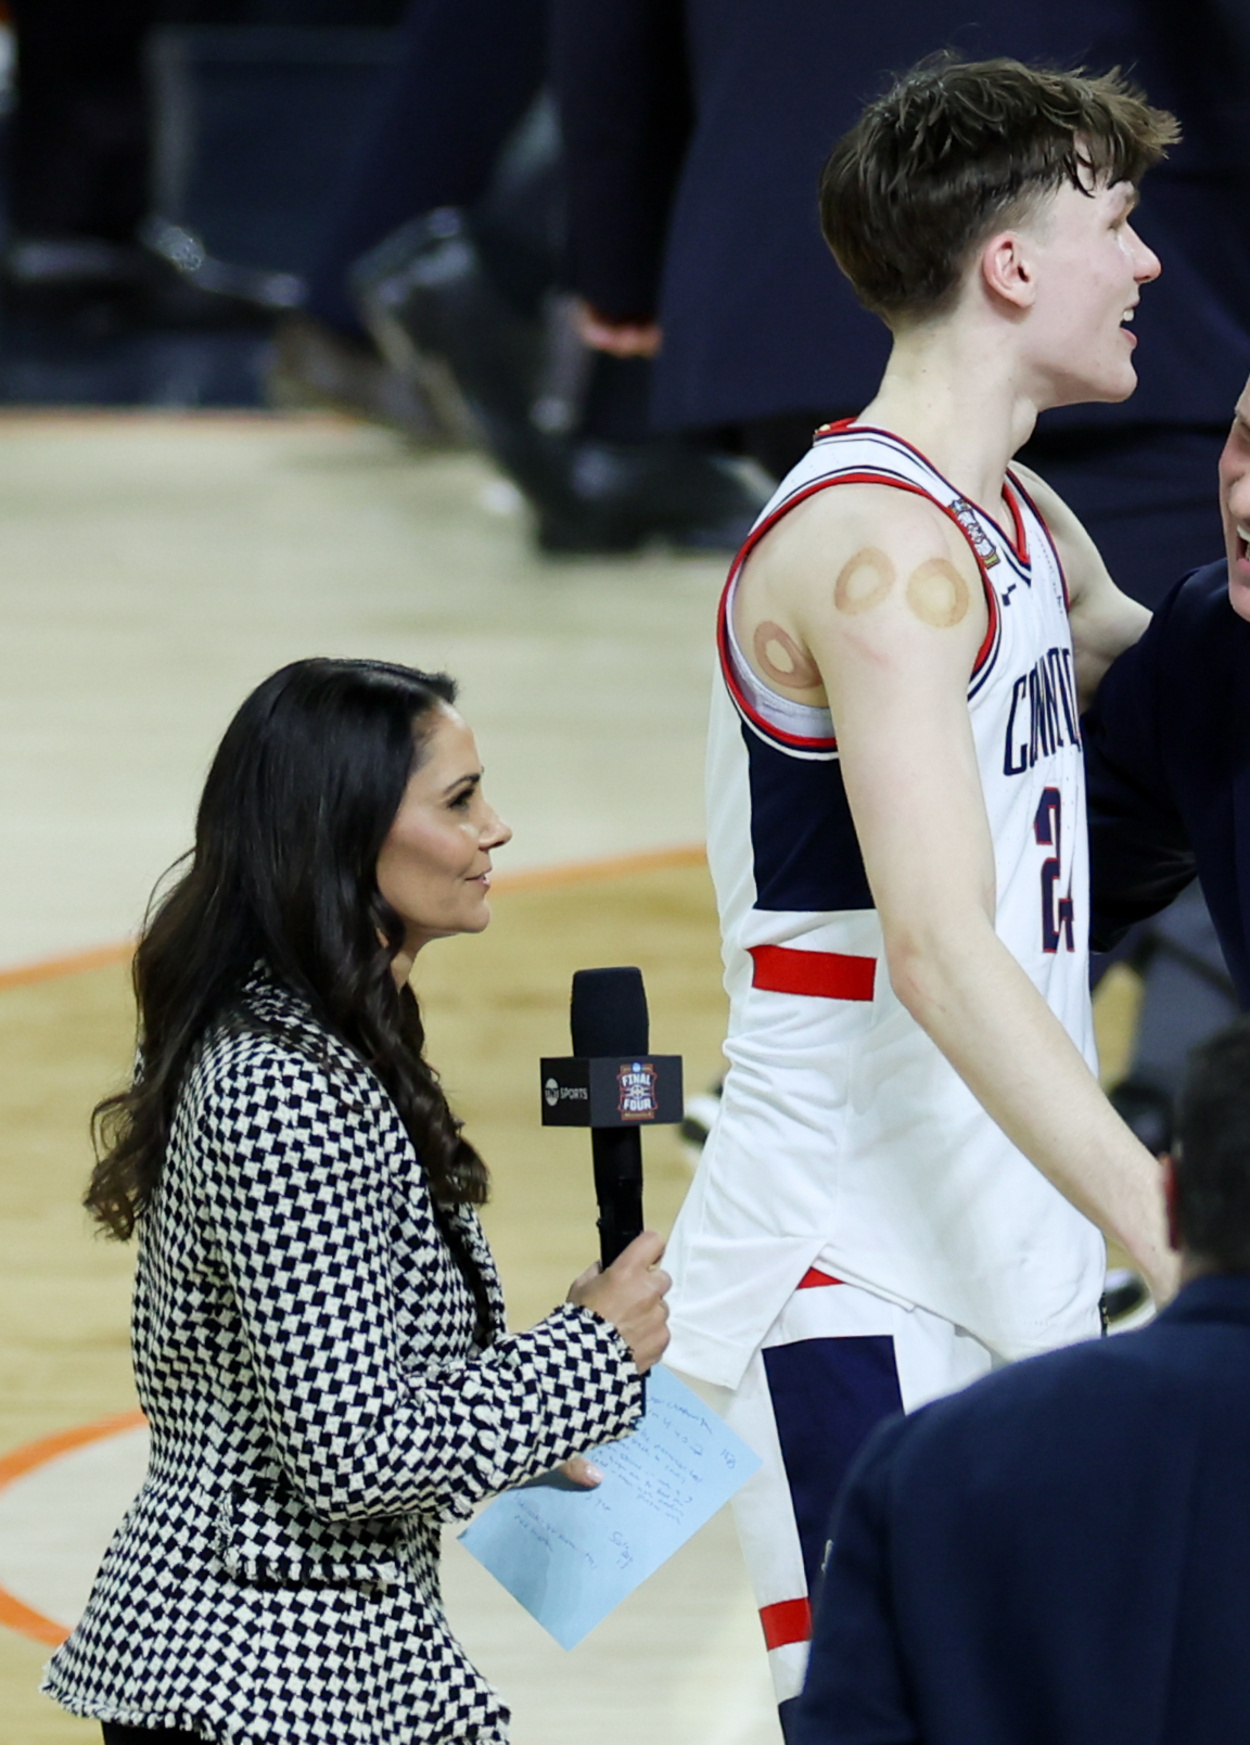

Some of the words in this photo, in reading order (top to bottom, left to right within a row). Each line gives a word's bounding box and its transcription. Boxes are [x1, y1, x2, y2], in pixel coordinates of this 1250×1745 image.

[622, 1072, 652, 1087] FINAL
[560, 1087, 588, 1100] SPORTS
[623, 1097, 652, 1111] FOUR
